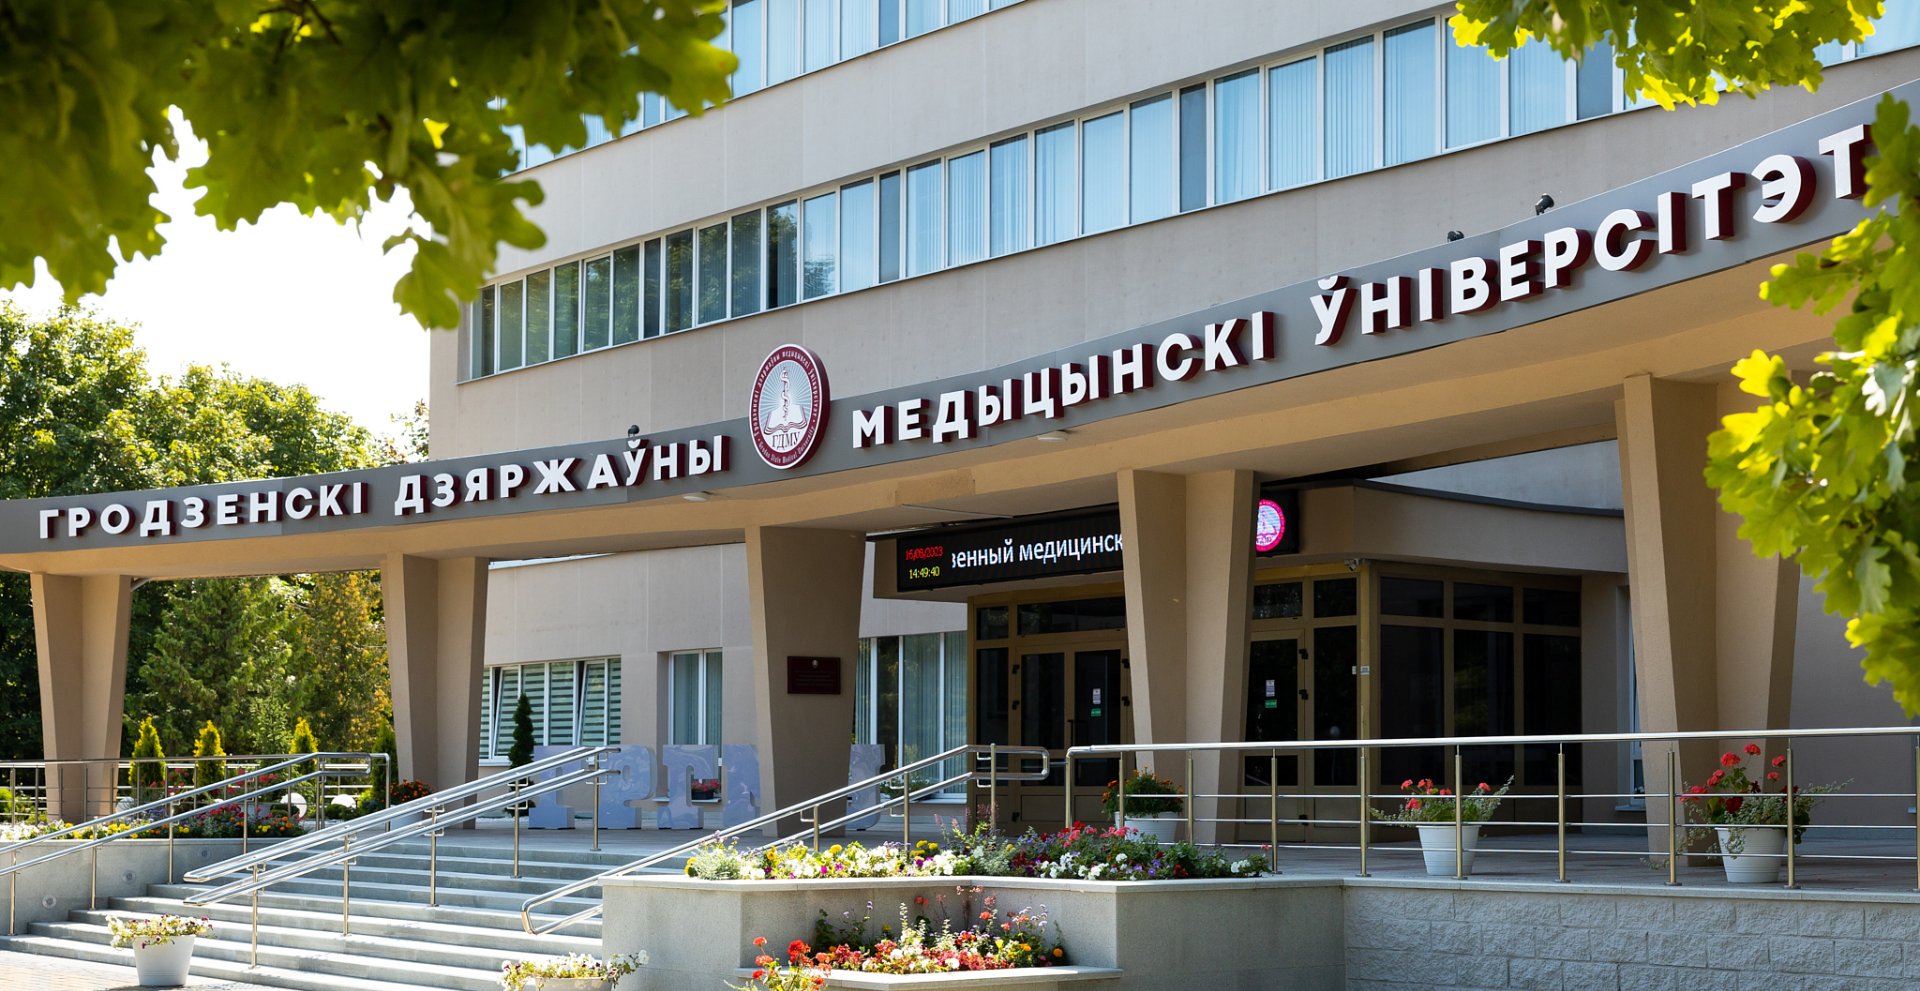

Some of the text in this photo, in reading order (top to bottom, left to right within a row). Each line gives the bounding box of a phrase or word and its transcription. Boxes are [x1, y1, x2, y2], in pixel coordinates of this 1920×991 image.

[39, 124, 1869, 539] ГРОДЗЕНСКІ ДЗЯРЖАЎНЫ МЕДЫЦЫНСКІ ЎНІВЕРСІТЭТ
[772, 431, 800, 451] ГДМУ
[909, 566, 940, 580] 14:49:40
